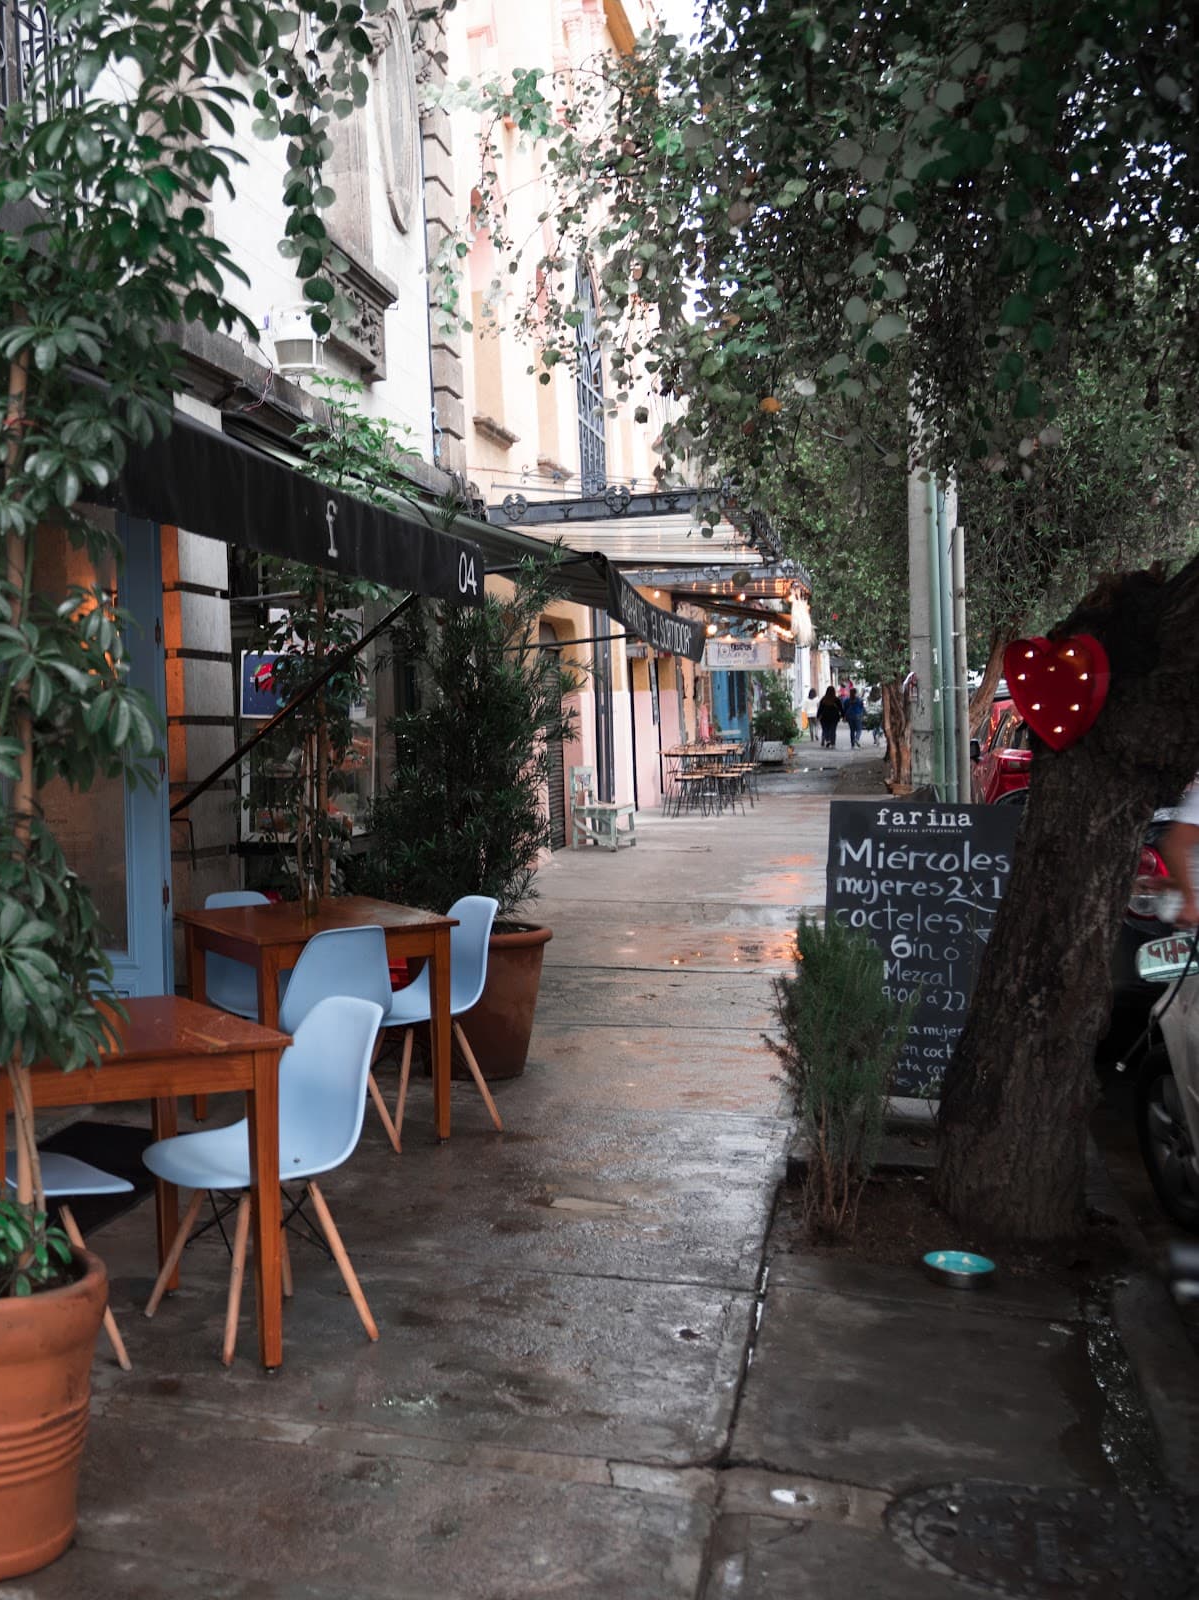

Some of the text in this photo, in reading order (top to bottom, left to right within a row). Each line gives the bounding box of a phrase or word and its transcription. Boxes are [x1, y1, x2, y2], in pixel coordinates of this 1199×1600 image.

[458, 551, 477, 595] 04
[876, 808, 973, 826] farina
[838, 837, 1011, 874] Miércoles
[836, 871, 944, 905] mujeres
[834, 900, 963, 935] cocteles
[883, 959, 953, 987] Mezcal
